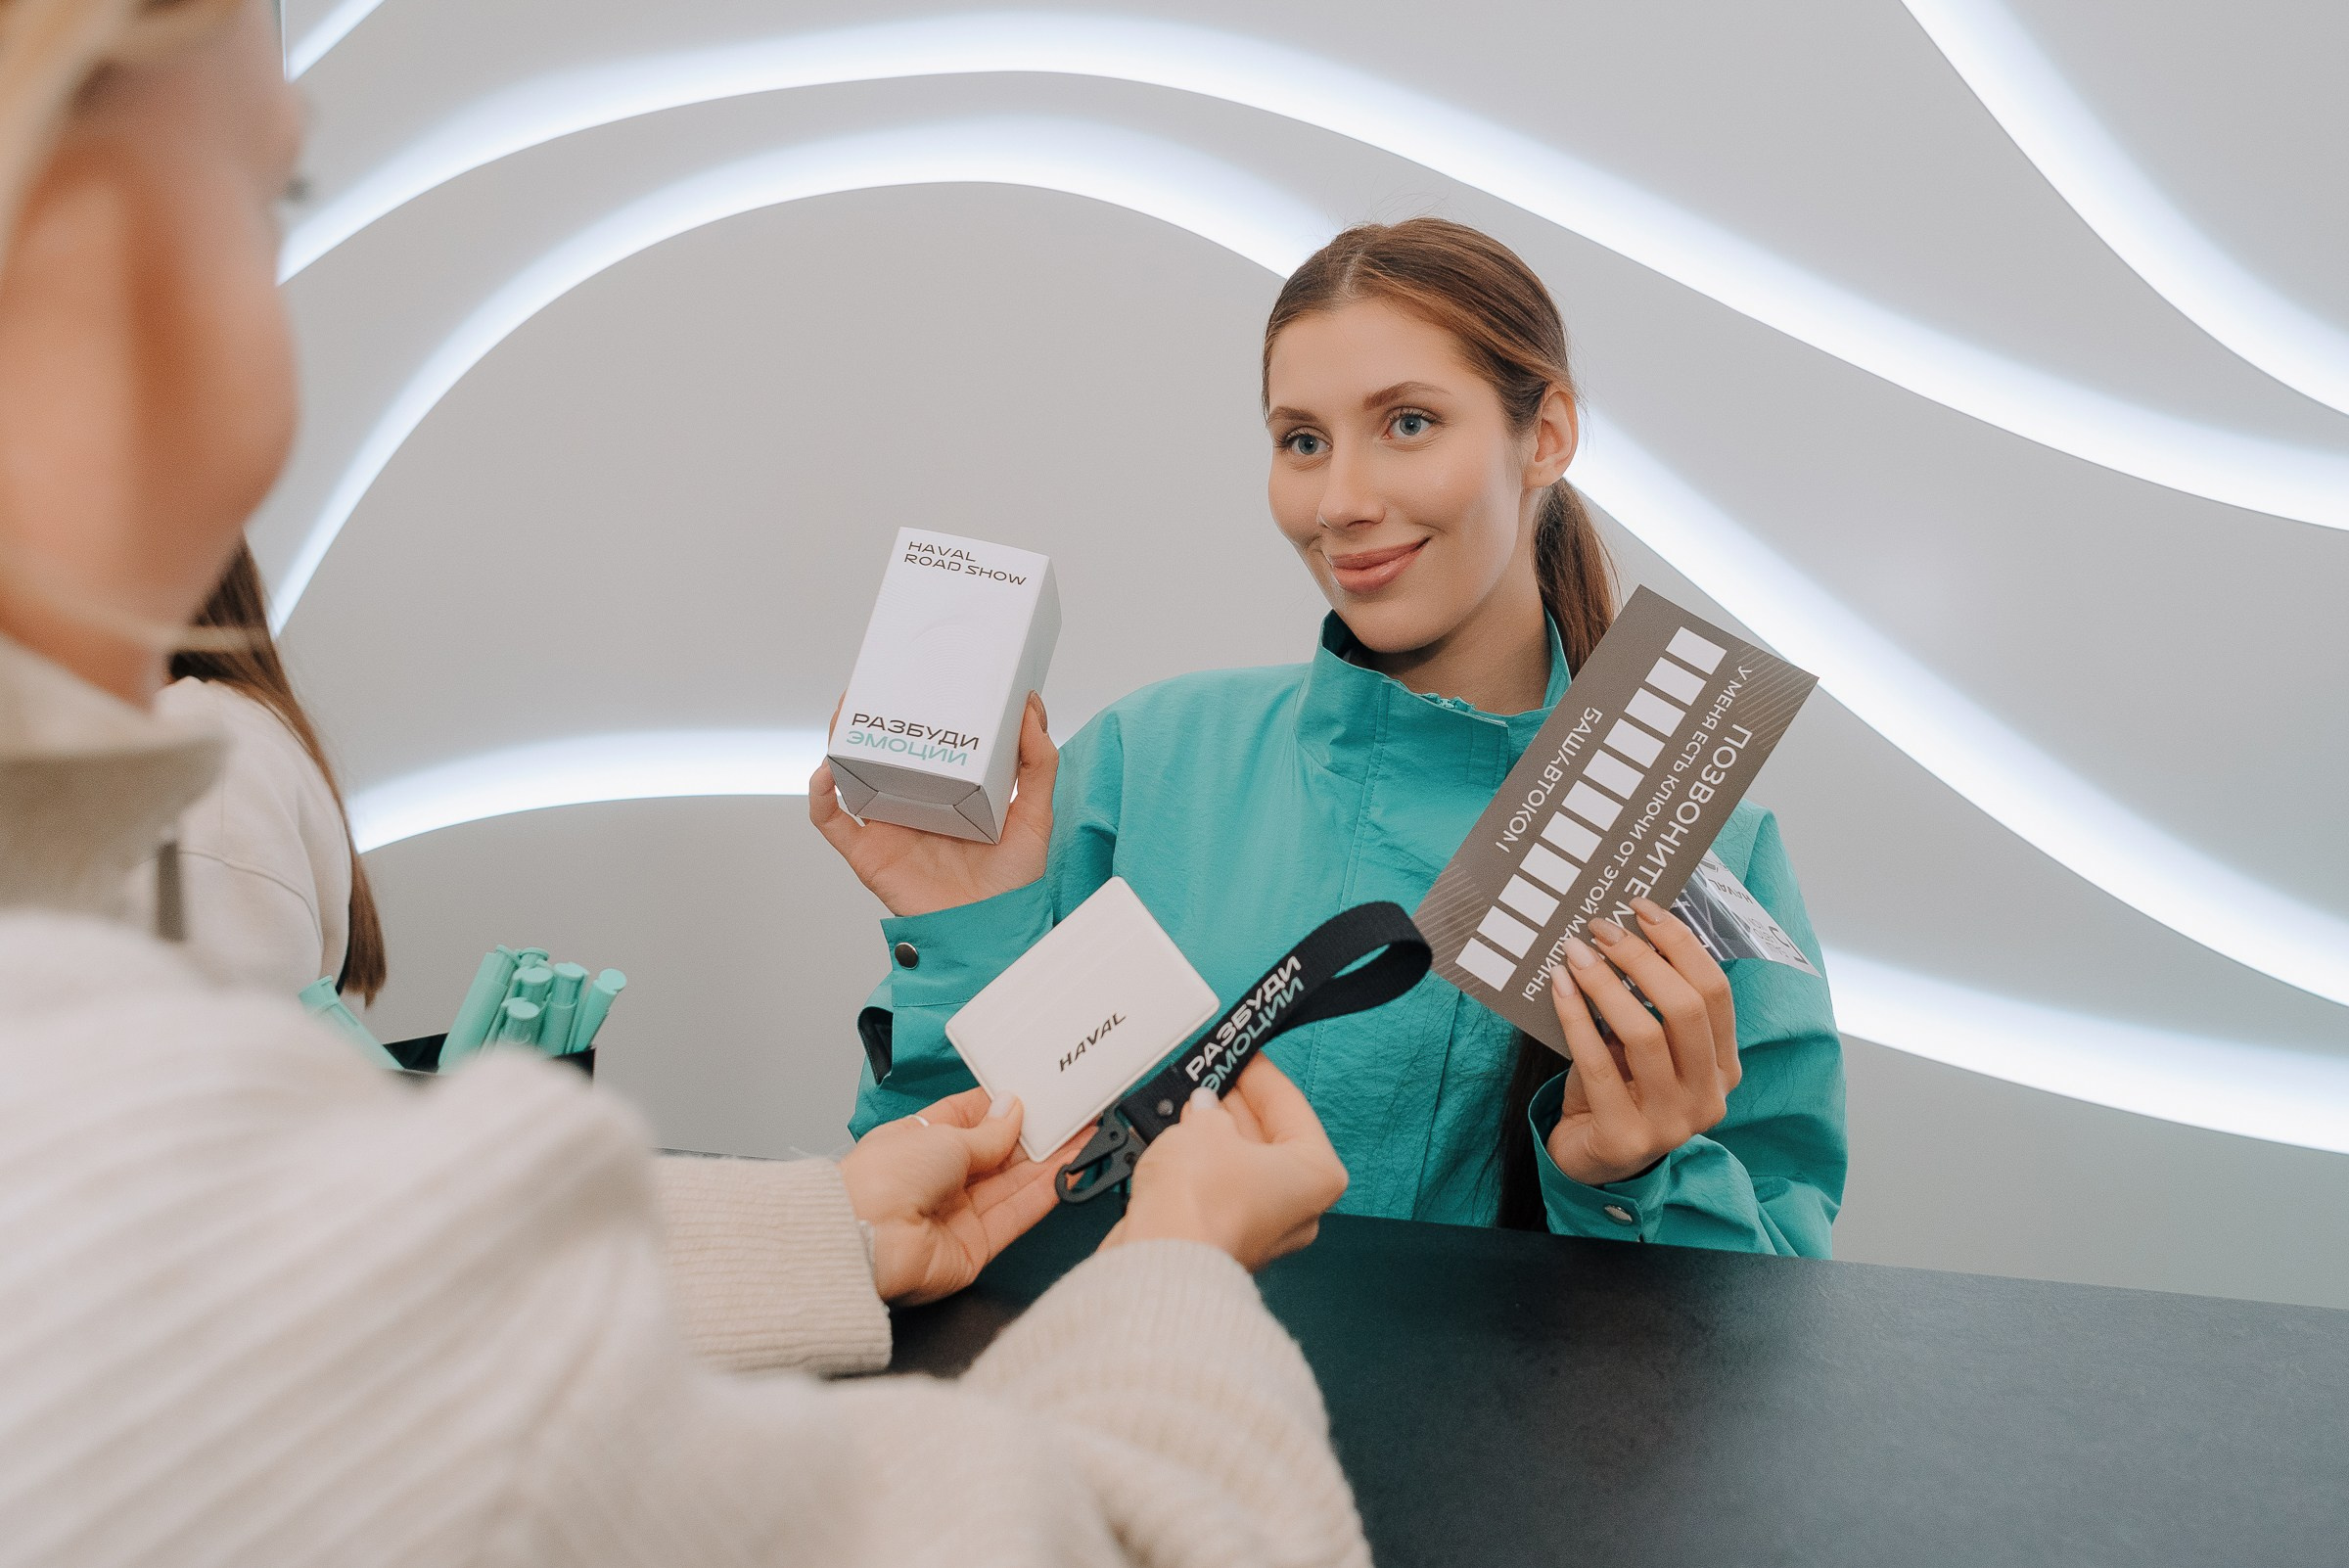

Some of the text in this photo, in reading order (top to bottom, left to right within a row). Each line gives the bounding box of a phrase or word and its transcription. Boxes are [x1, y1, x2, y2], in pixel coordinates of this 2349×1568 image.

[903, 553, 1028, 585] ROAD SHOW
[907, 541, 977, 563] HAVAL
[1737, 666, 1753, 680] У
[1701, 680, 1742, 730] МЕНЯ
[846, 730, 969, 766] ЭМОЦИИ
[852, 713, 980, 751] РАЗБУДИ
[1673, 730, 1709, 772] ЕСТЬ
[1624, 723, 1753, 899] ПОЗВОНИТЕ
[1629, 774, 1681, 840] КЛЮЧИ
[1613, 841, 1635, 867] ОТ
[1580, 865, 1620, 915] ЭТОЙ
[1184, 955, 1302, 1082] РАЗБУДИ
[1200, 976, 1305, 1093] ЭМОЦИИ
[1059, 1013, 1127, 1072] HAVAL
